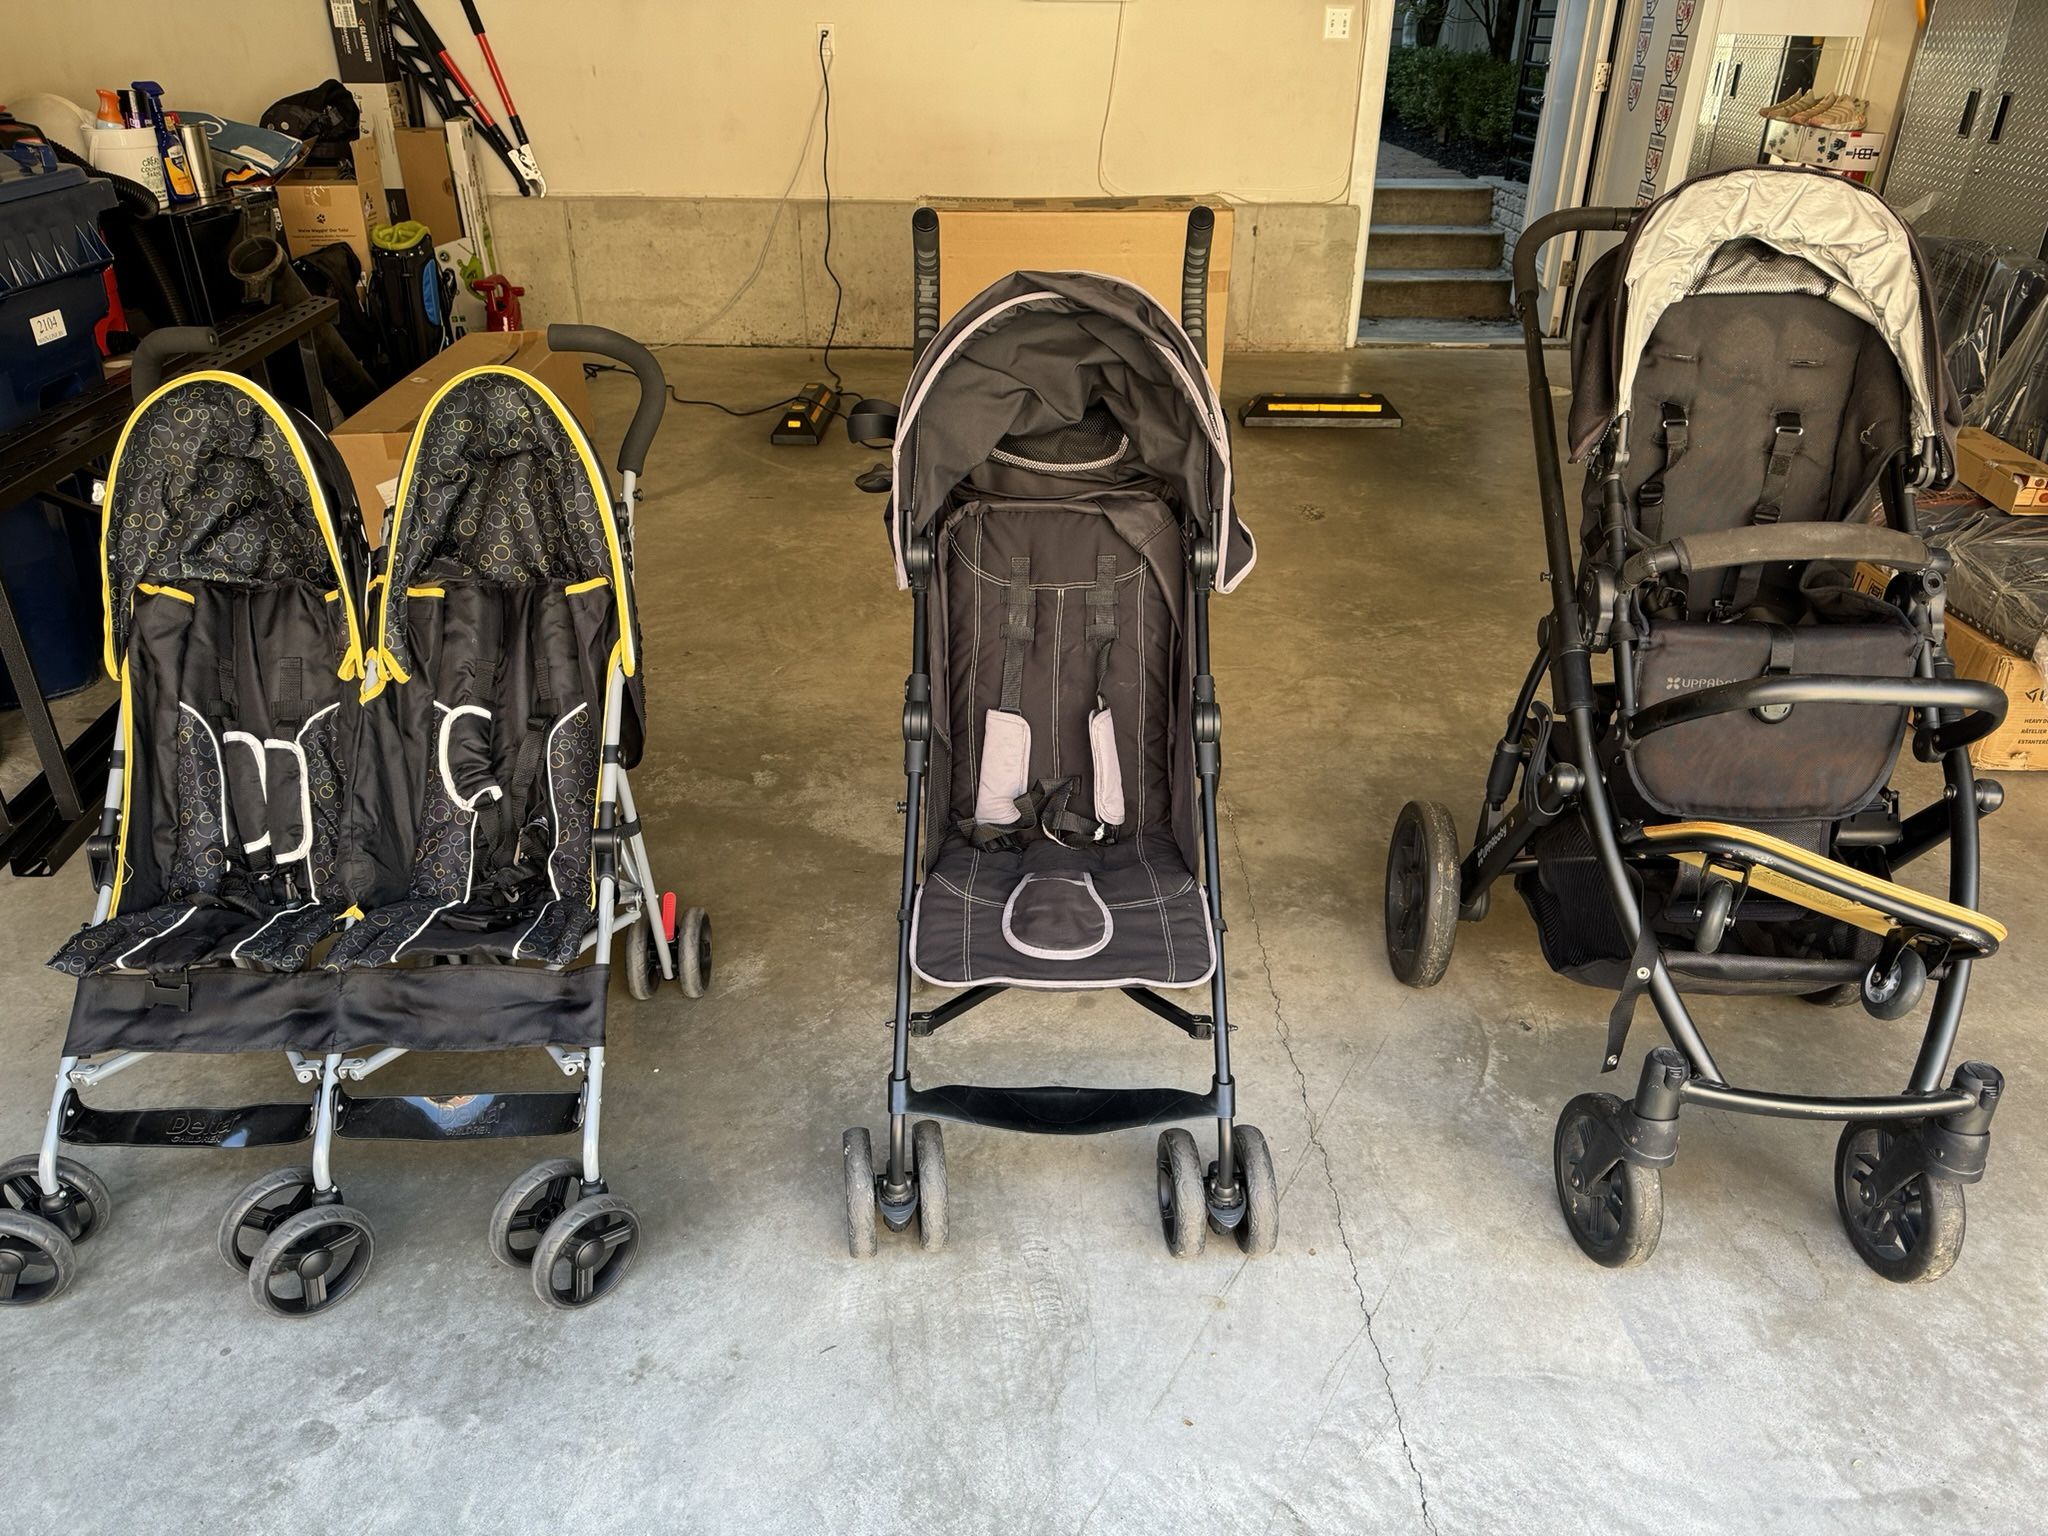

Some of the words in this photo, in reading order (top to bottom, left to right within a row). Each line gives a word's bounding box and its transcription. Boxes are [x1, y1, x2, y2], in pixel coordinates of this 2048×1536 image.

[360, 25, 373, 62] GLADIATOR
[37, 316, 57, 333] 2104
[166, 1111, 233, 1136] Delta
